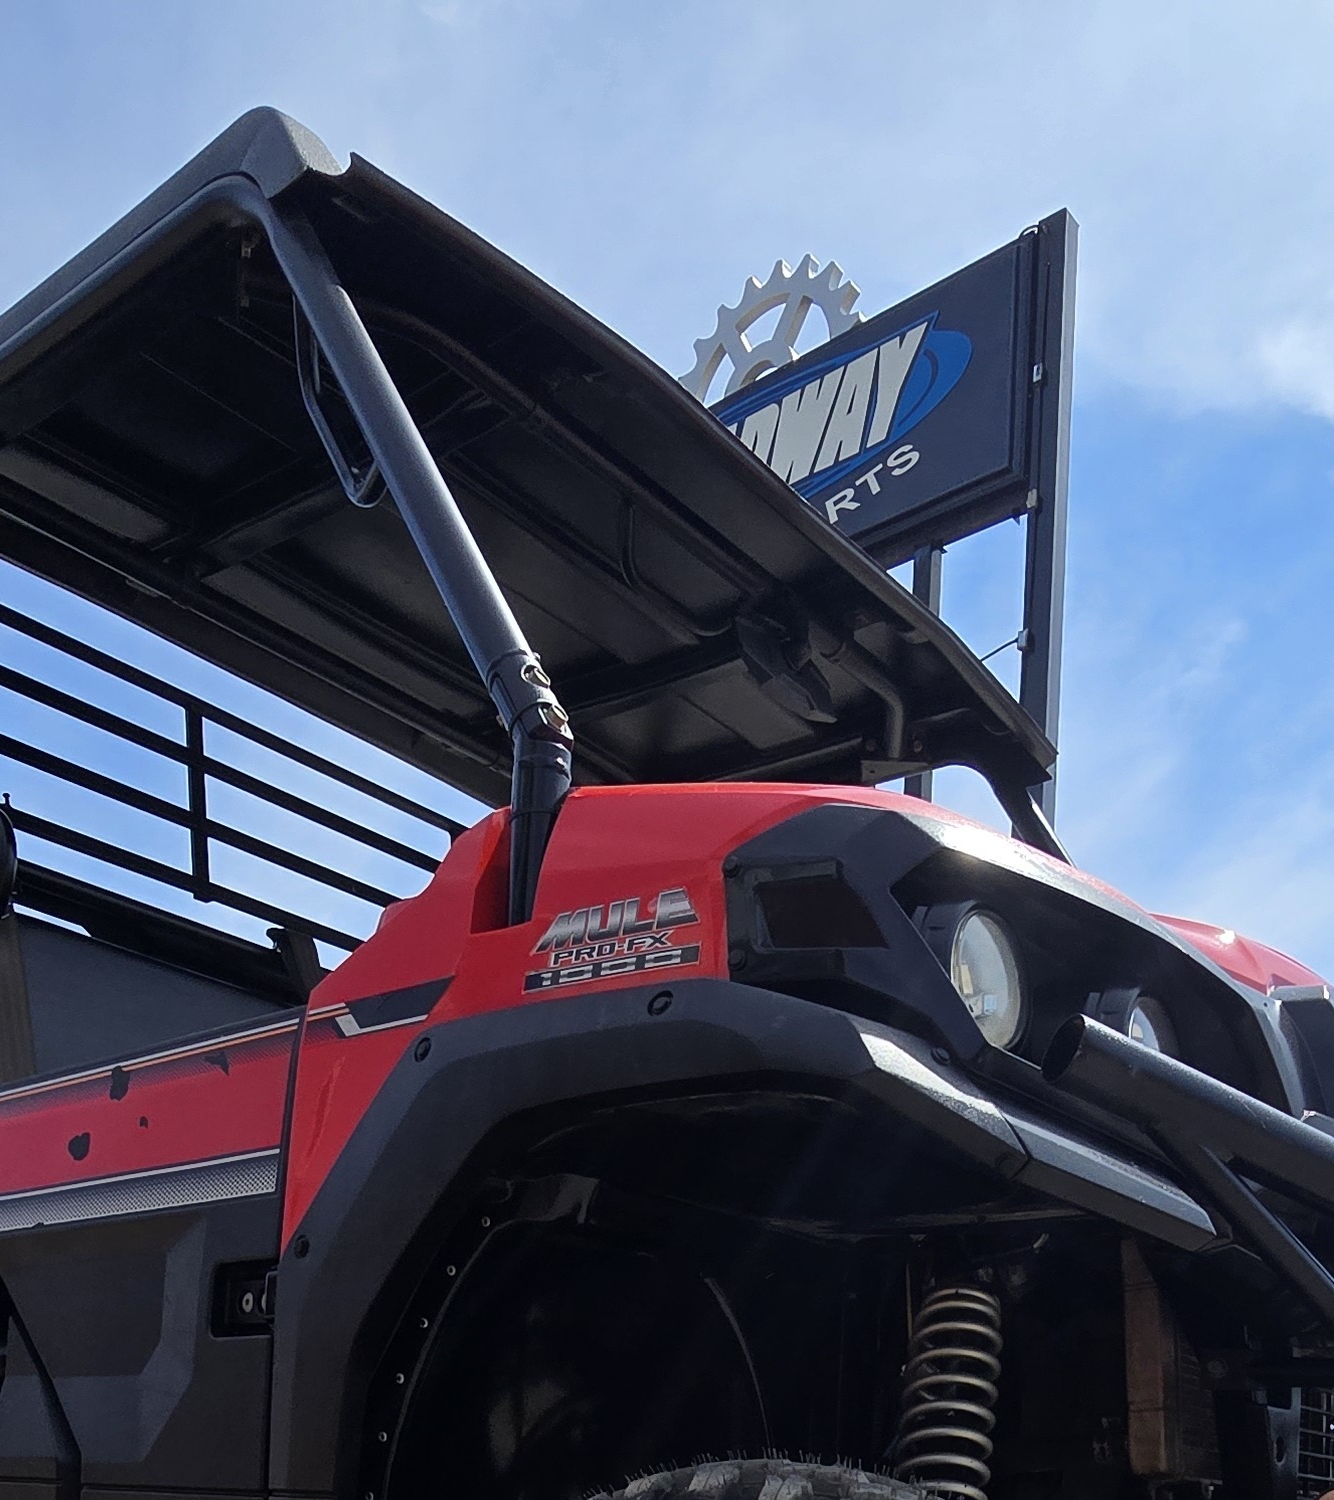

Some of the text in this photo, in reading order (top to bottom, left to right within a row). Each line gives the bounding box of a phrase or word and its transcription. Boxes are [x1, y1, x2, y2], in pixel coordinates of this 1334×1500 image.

[728, 323, 930, 484] DWAY
[531, 886, 700, 955] MULE
[541, 950, 681, 986] 1000
[550, 930, 674, 967] PRO-FX
